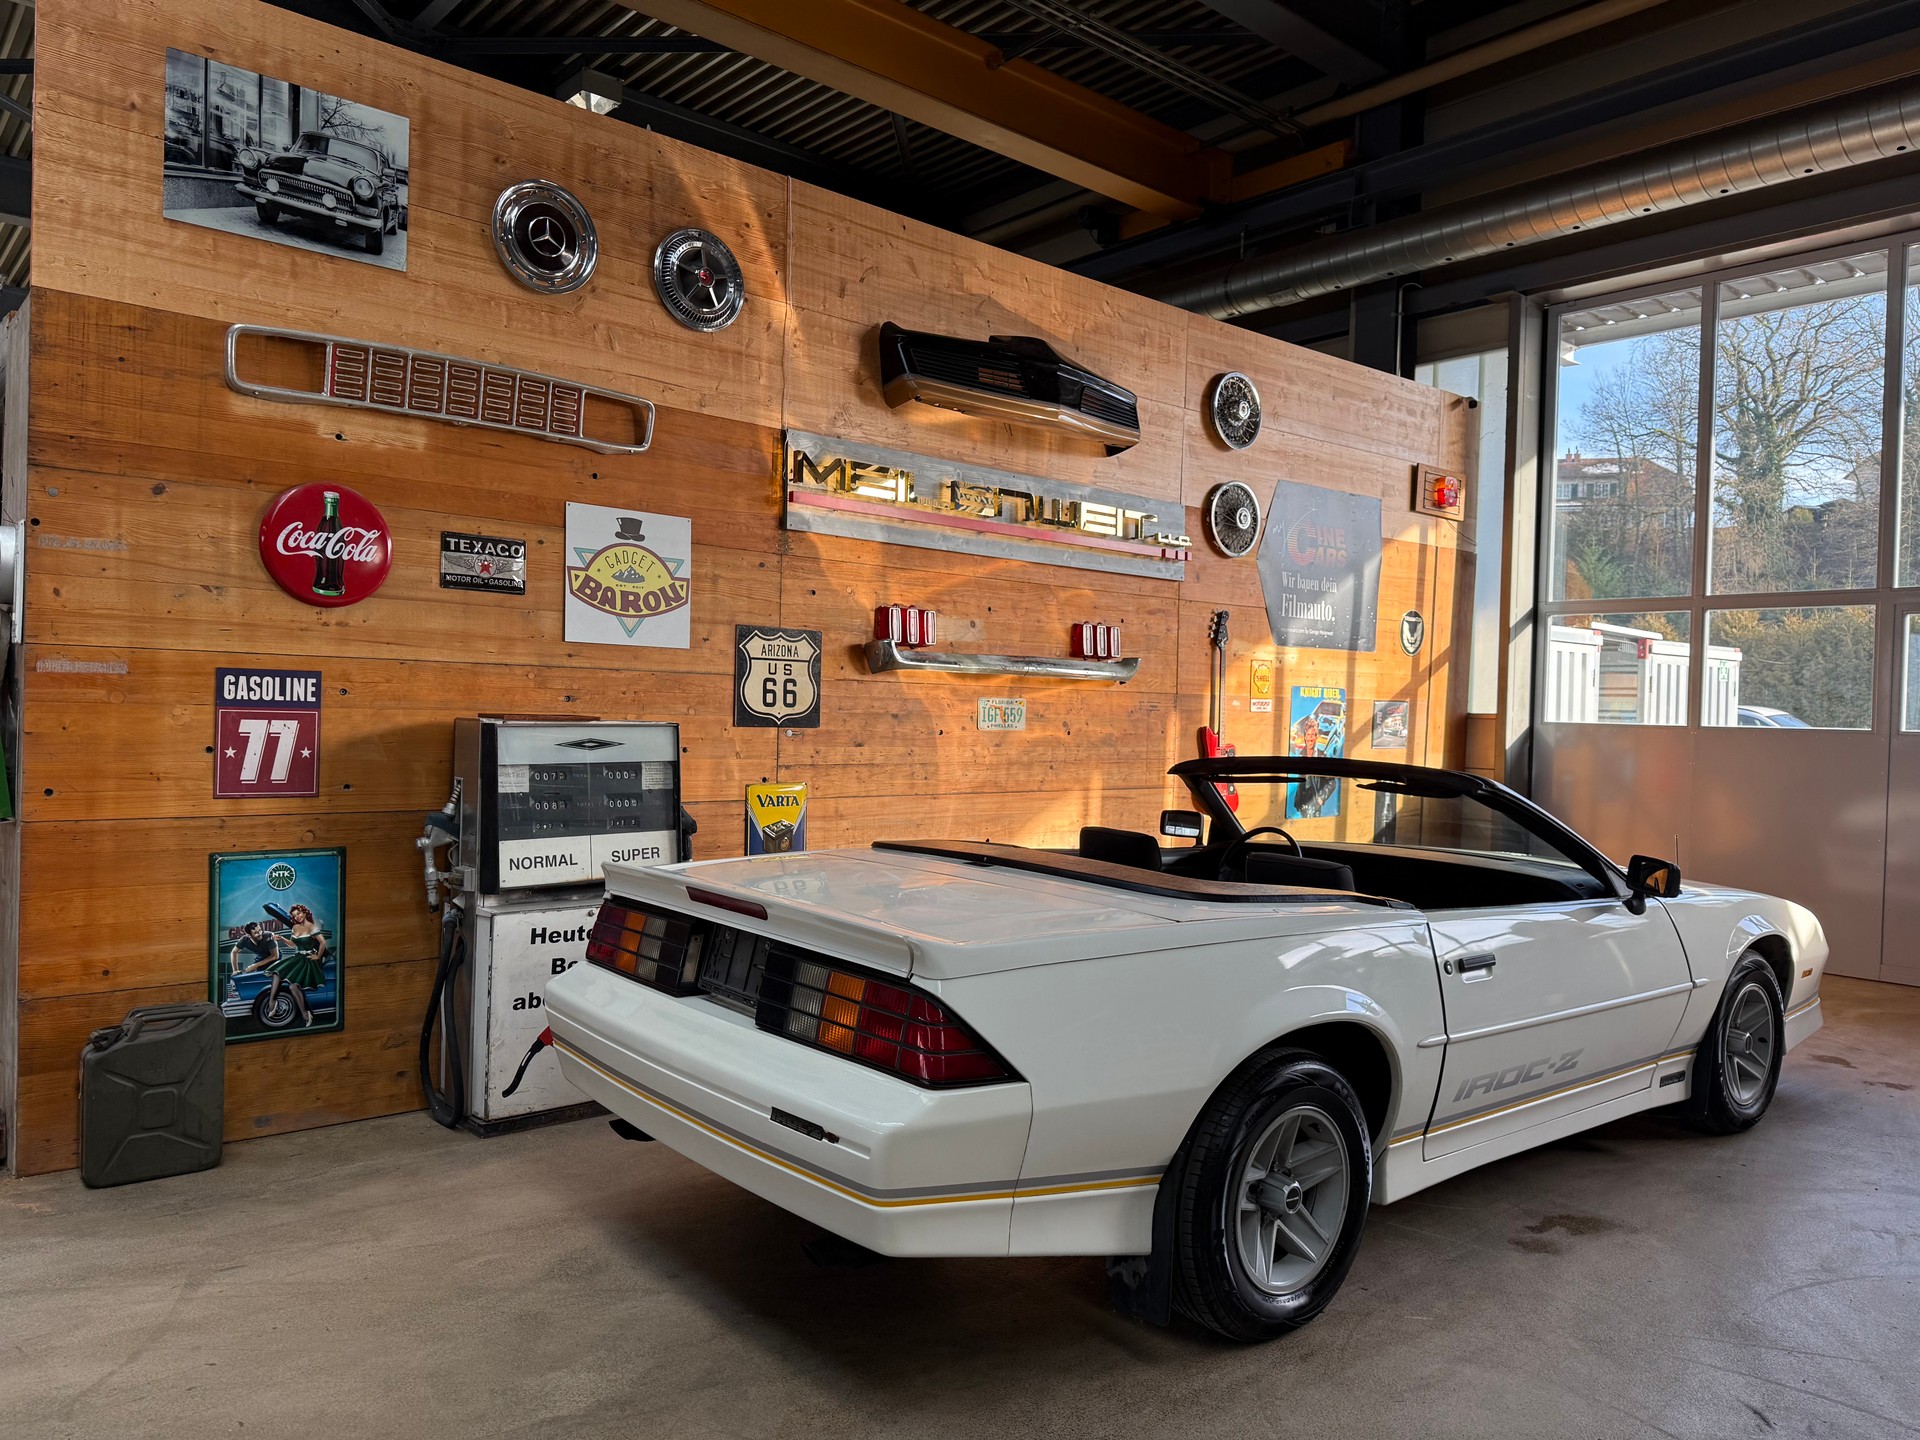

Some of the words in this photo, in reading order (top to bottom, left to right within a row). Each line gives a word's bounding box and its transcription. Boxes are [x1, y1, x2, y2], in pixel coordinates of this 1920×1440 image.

[276, 521, 382, 562] Coca-Cola
[446, 537, 522, 558] TEXACO
[604, 550, 656, 573] GADGET
[445, 574, 472, 583] MOTOR
[472, 577, 484, 585] OIL
[488, 578, 524, 588] GASOLINE
[1281, 571, 1296, 588] Wir
[1297, 573, 1319, 592] bauen
[1320, 576, 1338, 593] dein
[575, 573, 685, 613] BARON
[1281, 593, 1336, 622] Filmauto.
[761, 644, 799, 657] ARIZONA
[768, 663, 793, 676] US
[223, 674, 317, 702] GASOLINE
[762, 678, 797, 708] 66
[238, 719, 300, 784] 77
[756, 794, 800, 808] VARTA
[509, 853, 578, 871] NORMAL
[611, 846, 660, 863] SUPER
[512, 992, 546, 1011] ab
[1452, 1048, 1584, 1103] IROC-Z
